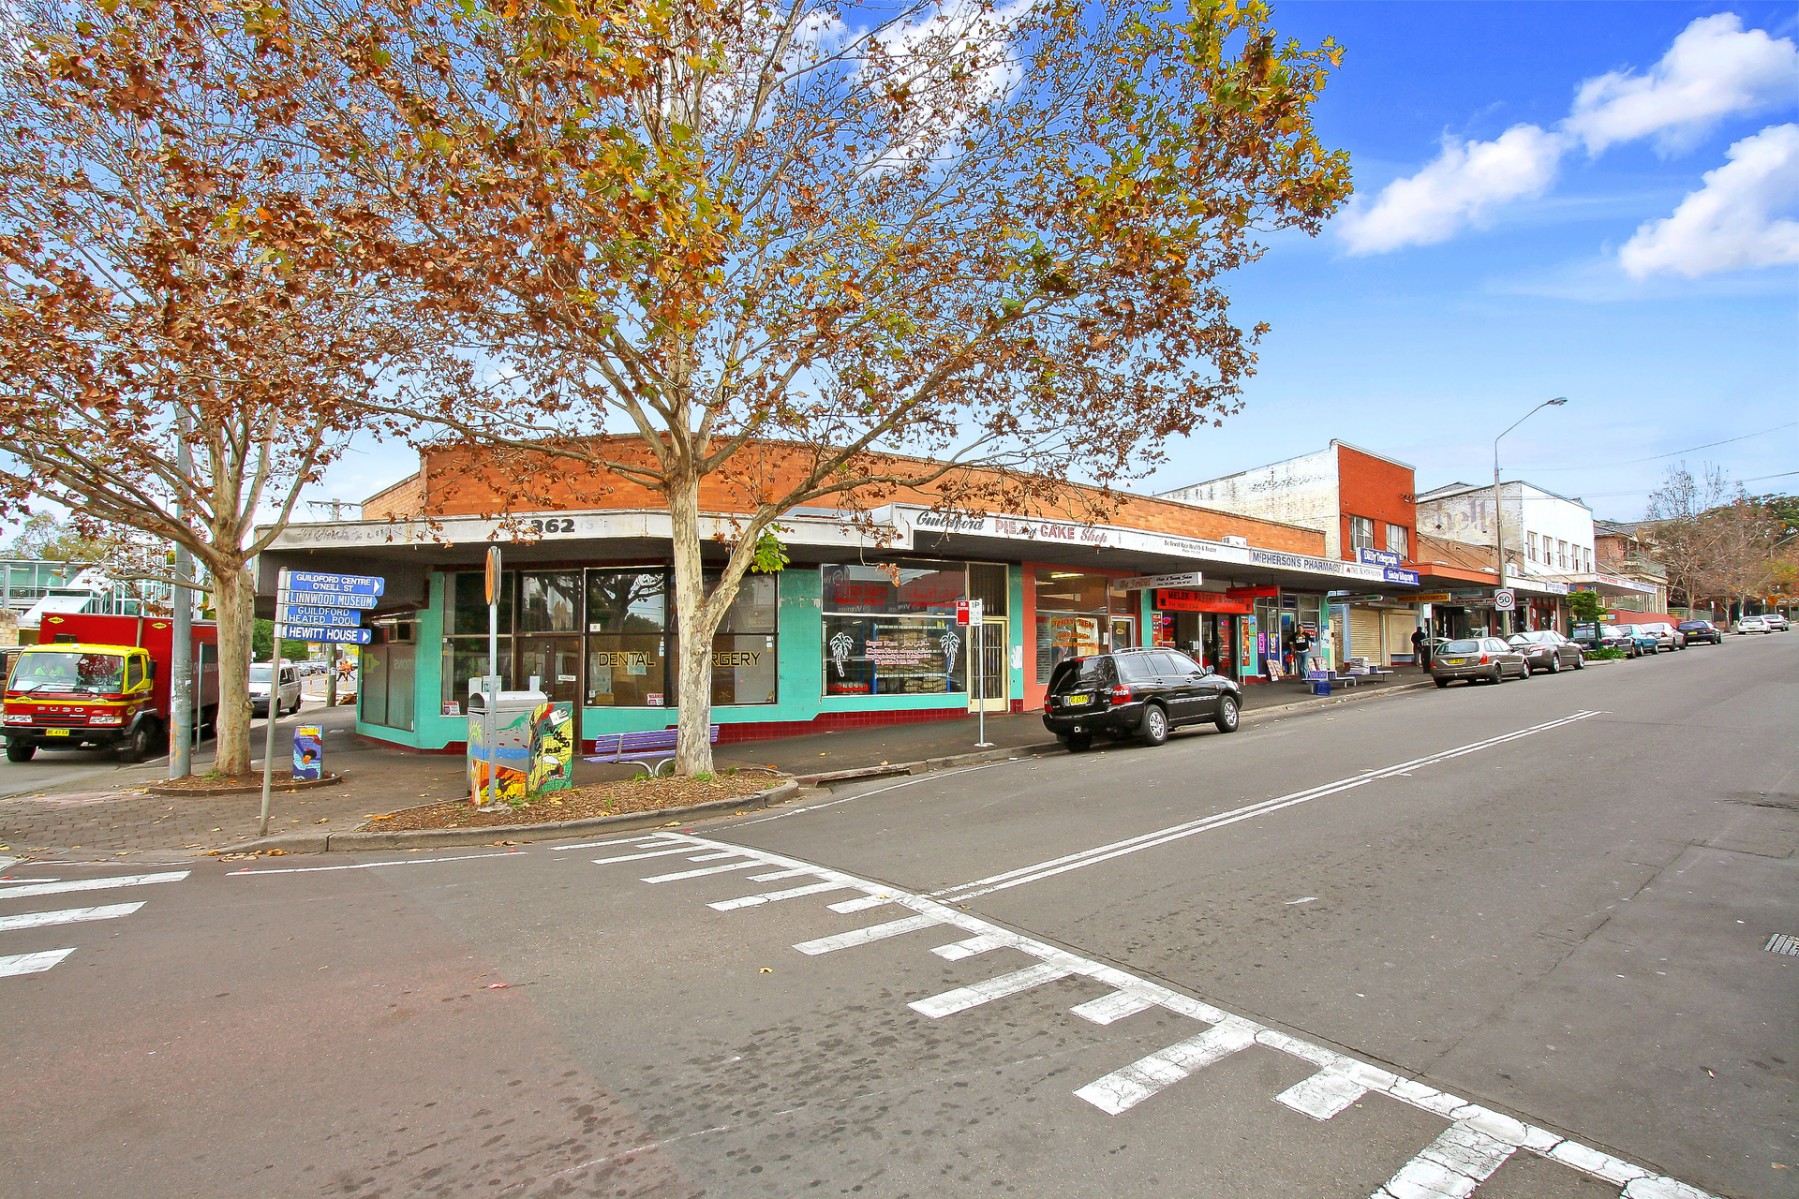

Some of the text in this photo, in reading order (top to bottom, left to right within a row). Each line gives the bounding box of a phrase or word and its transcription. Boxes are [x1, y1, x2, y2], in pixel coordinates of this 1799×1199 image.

[916, 511, 985, 531] Guildford
[995, 519, 1017, 534] PIE
[1040, 524, 1075, 540] CAKE
[1080, 528, 1108, 544] Shop
[296, 574, 371, 585] GUILDFORD CENTRE
[291, 592, 372, 607] LINNWOOD MUSEUM
[1498, 596, 1510, 604] 50
[297, 607, 350, 616] GUILDFORD
[289, 615, 355, 625] HEATED POOL
[289, 627, 357, 640] HEWITT HOUSE
[598, 652, 761, 667] DENTAL RGERY
